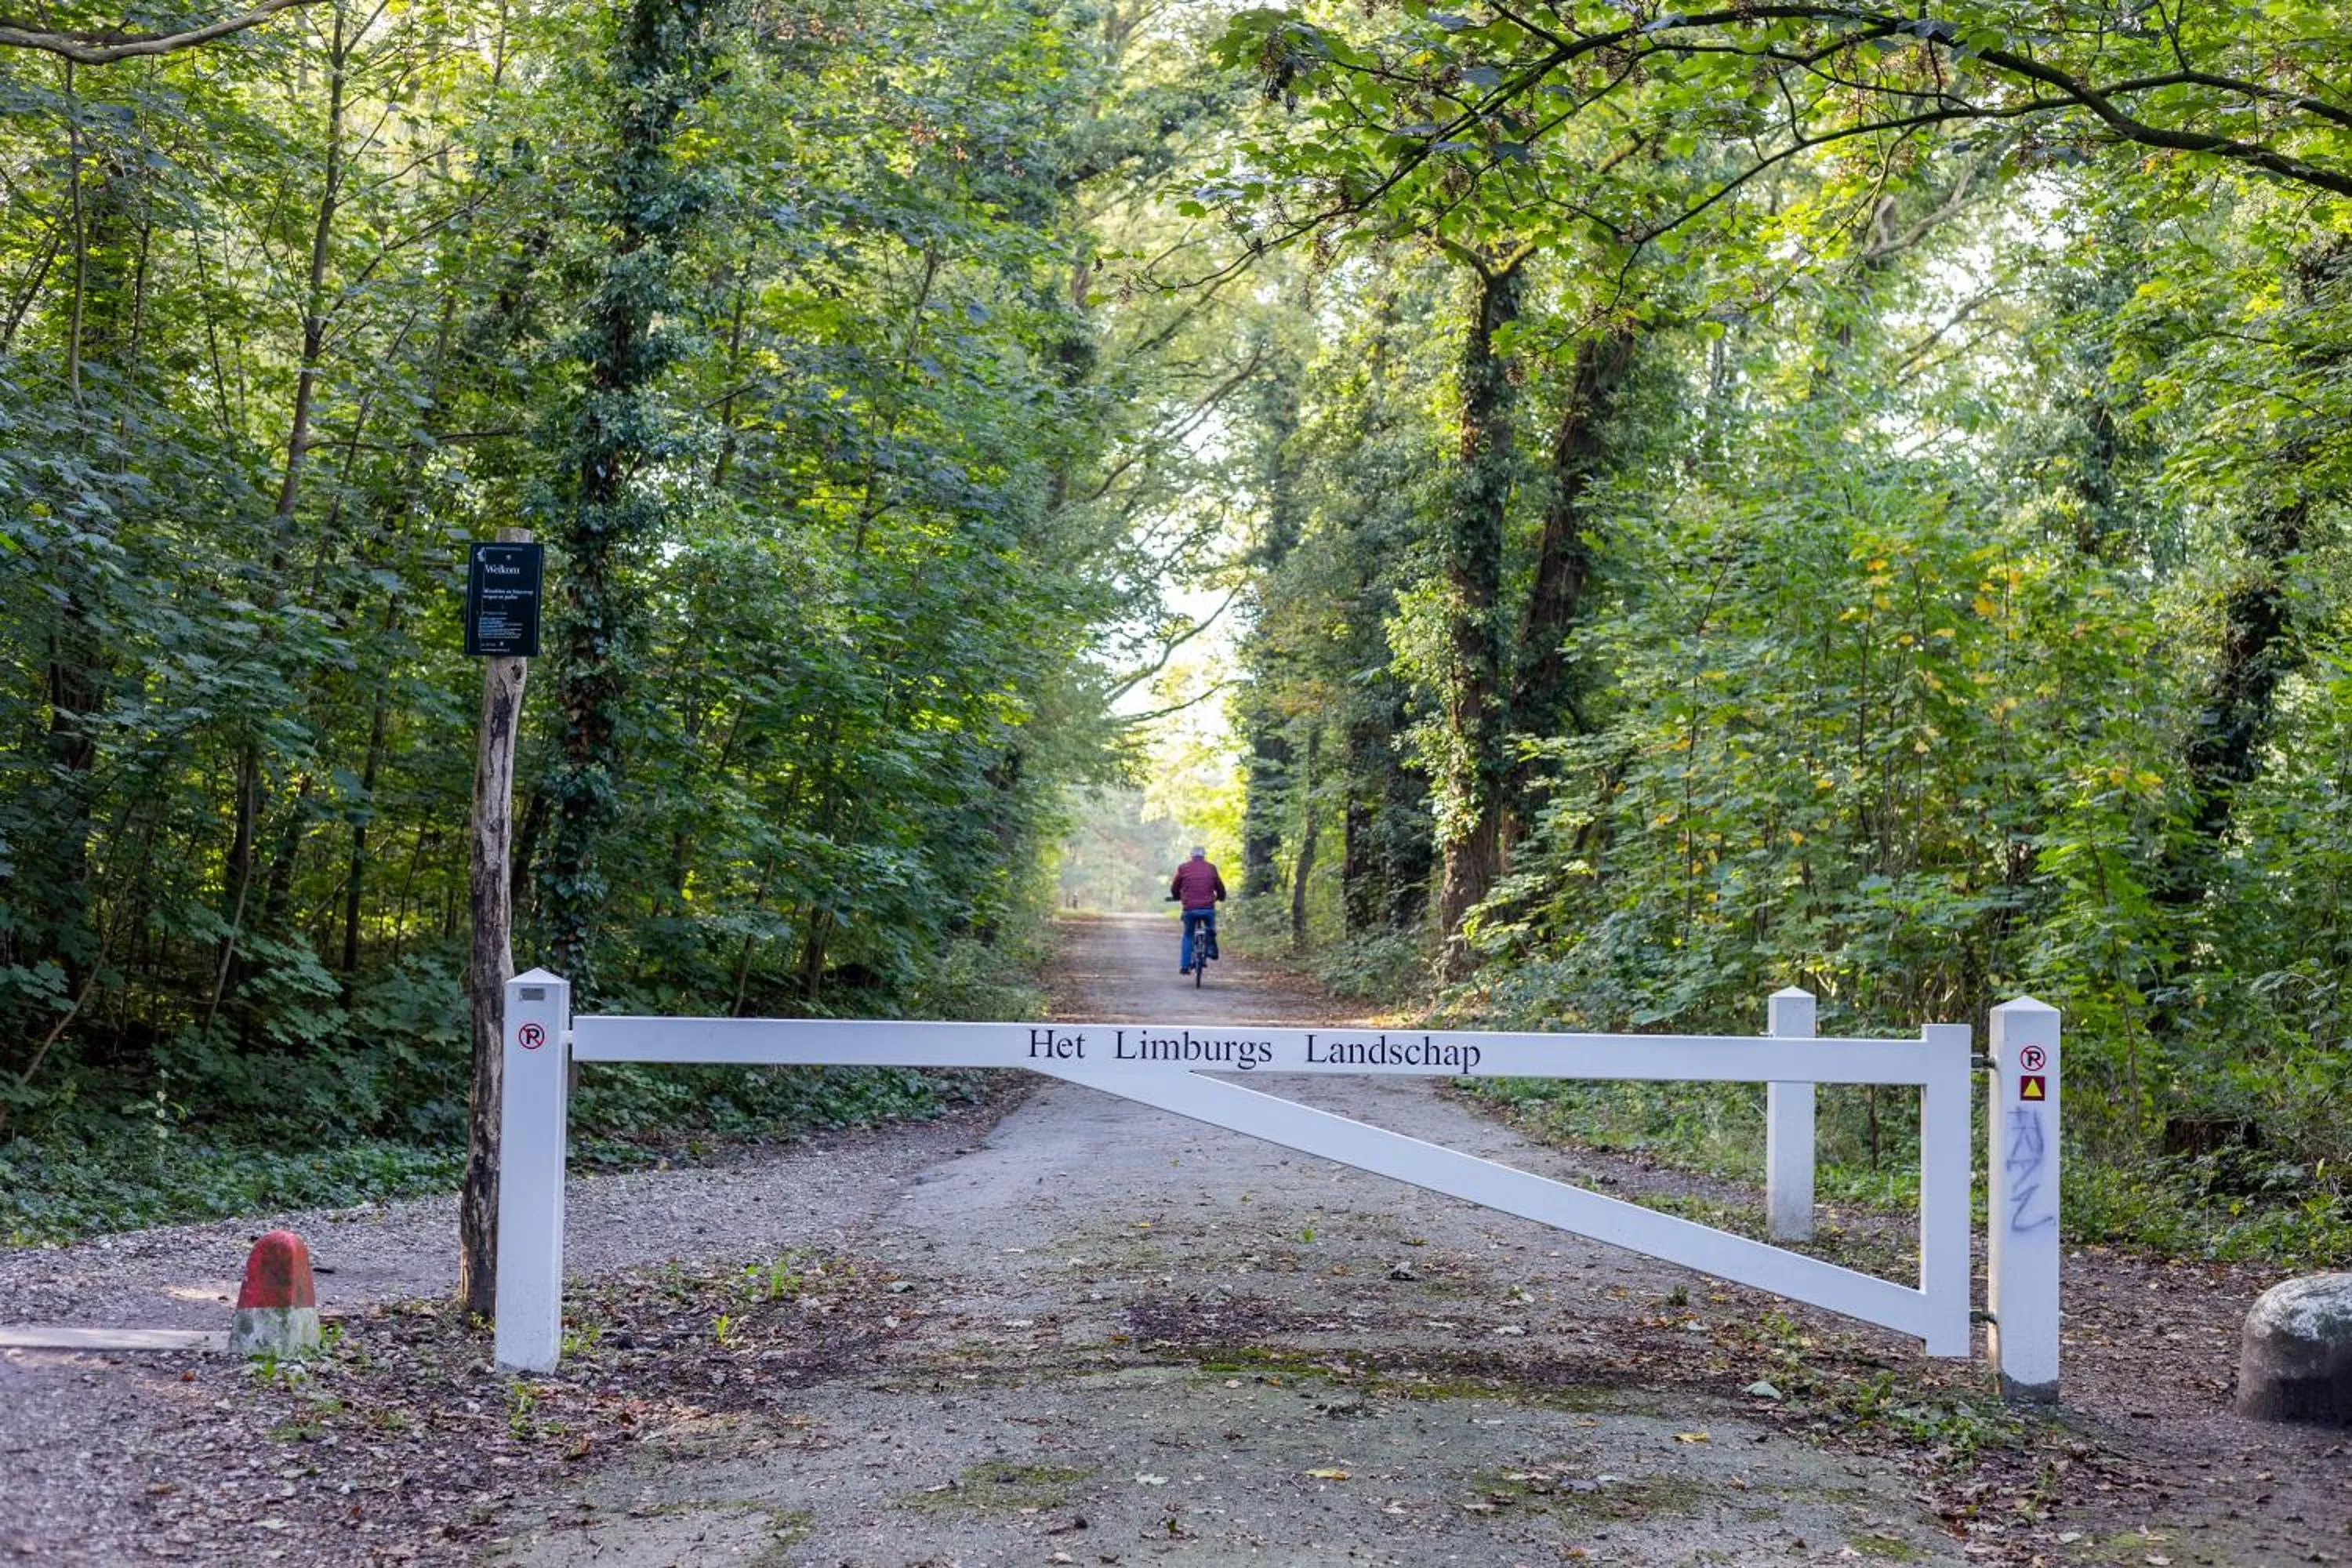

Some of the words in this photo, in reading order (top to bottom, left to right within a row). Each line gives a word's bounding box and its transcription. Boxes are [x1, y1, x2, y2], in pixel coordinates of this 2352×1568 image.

[485, 564, 520, 575] Welkom
[1029, 1029, 1086, 1059] Het
[1113, 1029, 1272, 1069] Limburgs
[1306, 1035, 1481, 1076] Landschap
